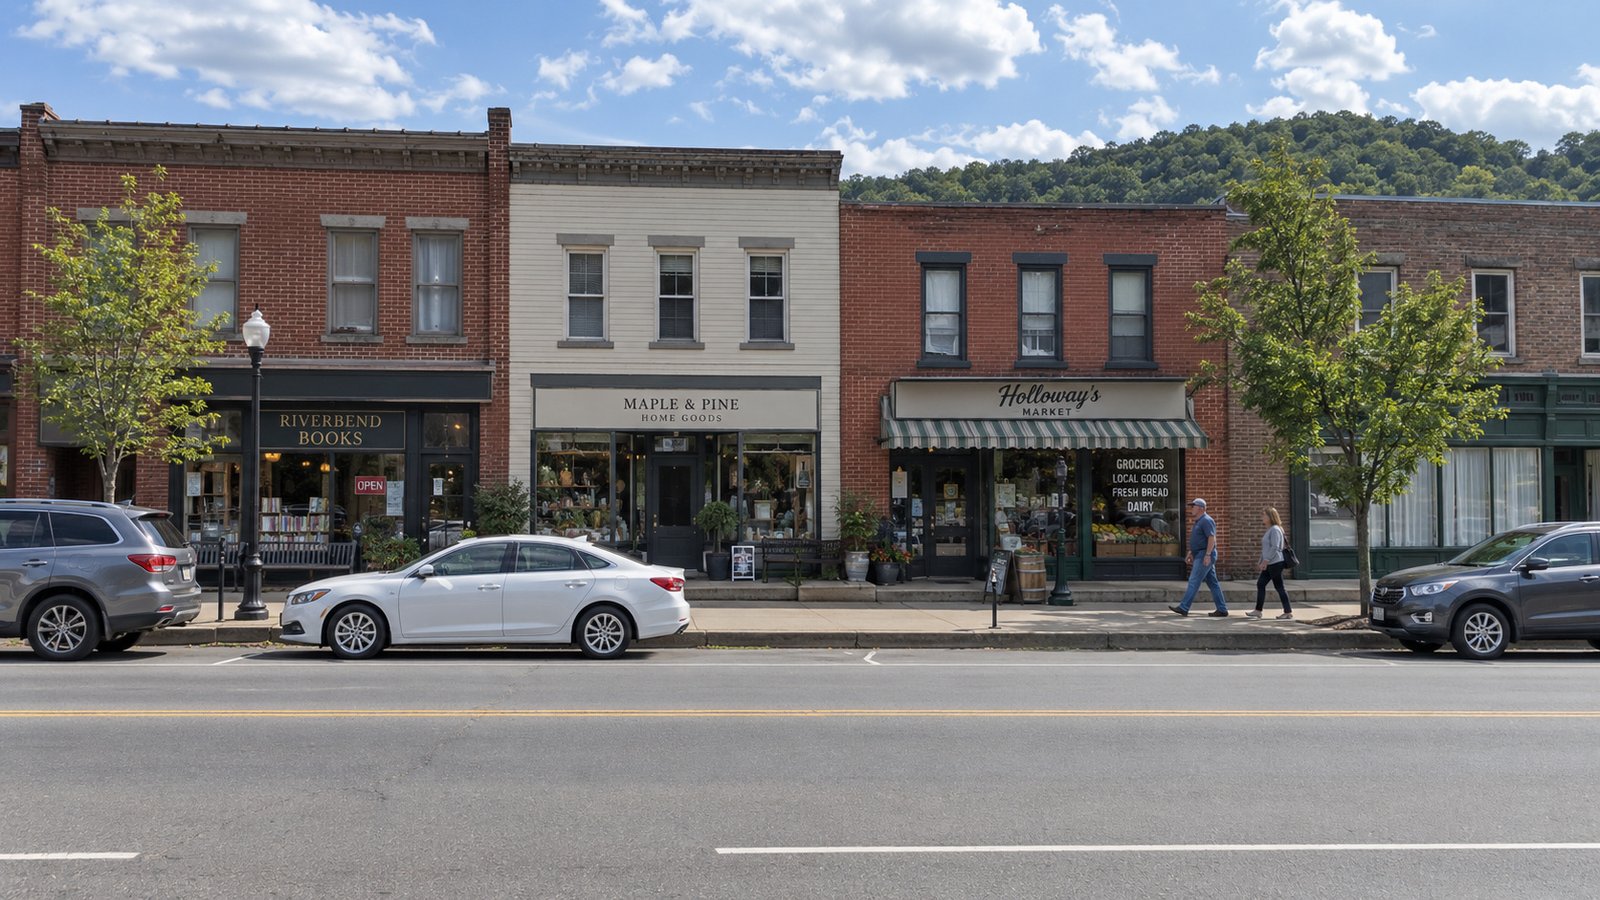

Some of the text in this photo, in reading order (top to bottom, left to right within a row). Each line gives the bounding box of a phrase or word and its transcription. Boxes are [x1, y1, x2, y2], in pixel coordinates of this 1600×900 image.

[998, 384, 1101, 409] Holloway's
[624, 398, 739, 410] MAPLE & PINE
[1022, 408, 1072, 416] MARKET
[280, 414, 382, 428] RIVERBEND
[641, 414, 722, 422] HOME GOODS
[299, 431, 362, 445] BOOKS
[1116, 458, 1165, 470] GROCERIES
[1112, 473, 1169, 483] LOCAL GOODS
[357, 480, 383, 491] OPEN
[1112, 487, 1169, 497] FRESH BREAD
[1127, 501, 1154, 512] DAIRY
